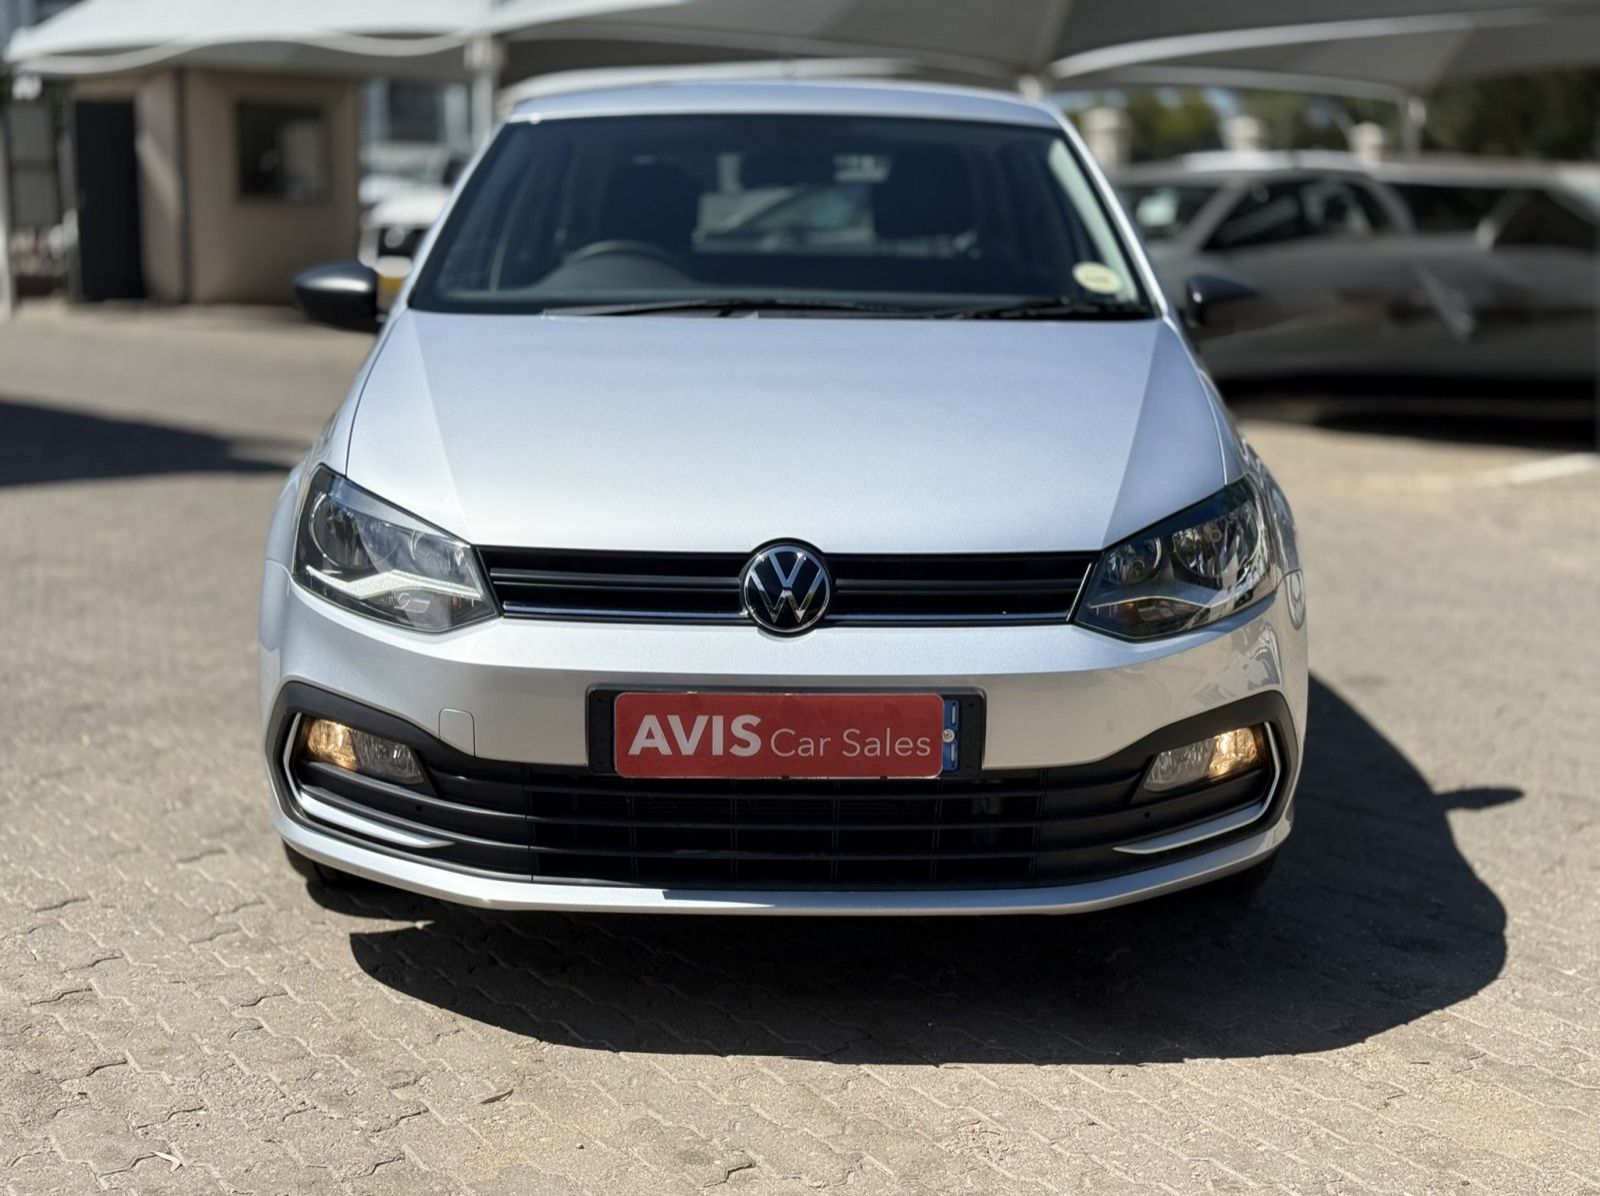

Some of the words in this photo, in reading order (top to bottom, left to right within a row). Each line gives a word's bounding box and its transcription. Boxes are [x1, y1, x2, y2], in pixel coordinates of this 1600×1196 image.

[747, 547, 826, 625] VW
[628, 714, 762, 757] AVIS
[770, 728, 832, 757] Car
[842, 726, 931, 757] Sales
